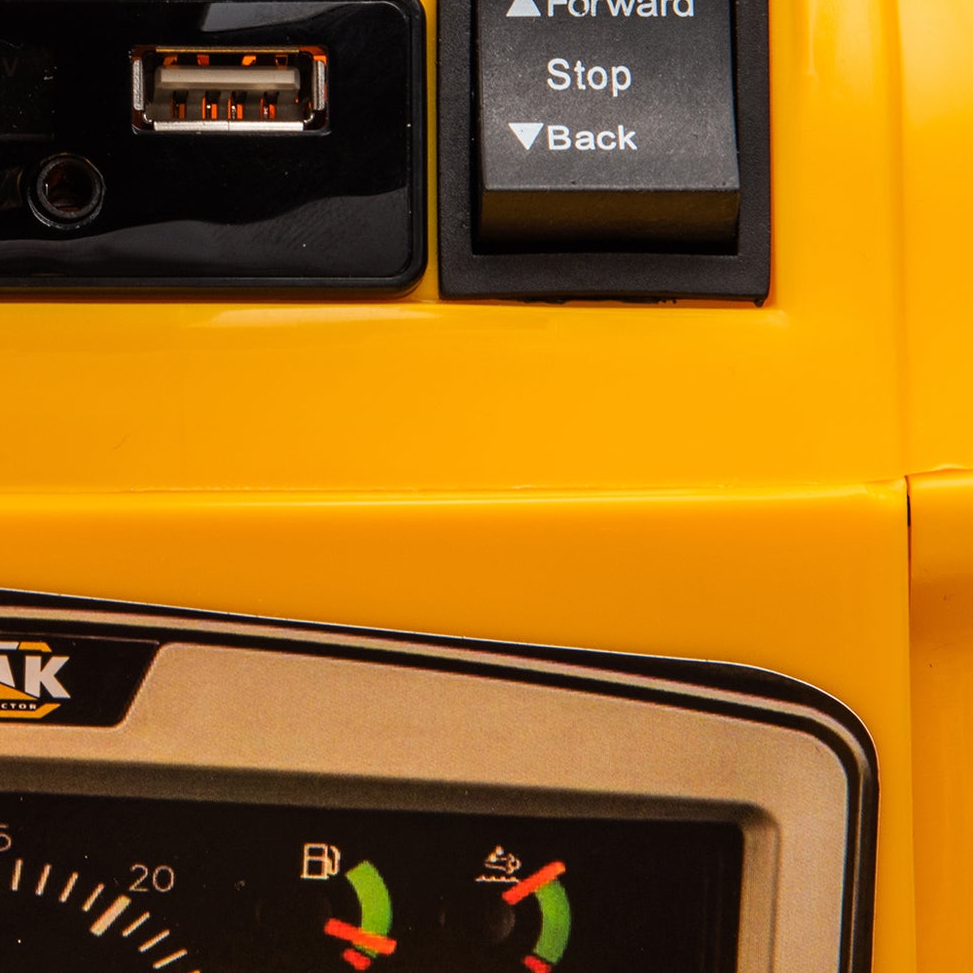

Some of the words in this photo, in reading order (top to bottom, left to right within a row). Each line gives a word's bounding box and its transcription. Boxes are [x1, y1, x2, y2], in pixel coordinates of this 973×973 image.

[546, 58, 632, 97] Stop
[547, 124, 638, 151] Back
[129, 865, 175, 892] 20
